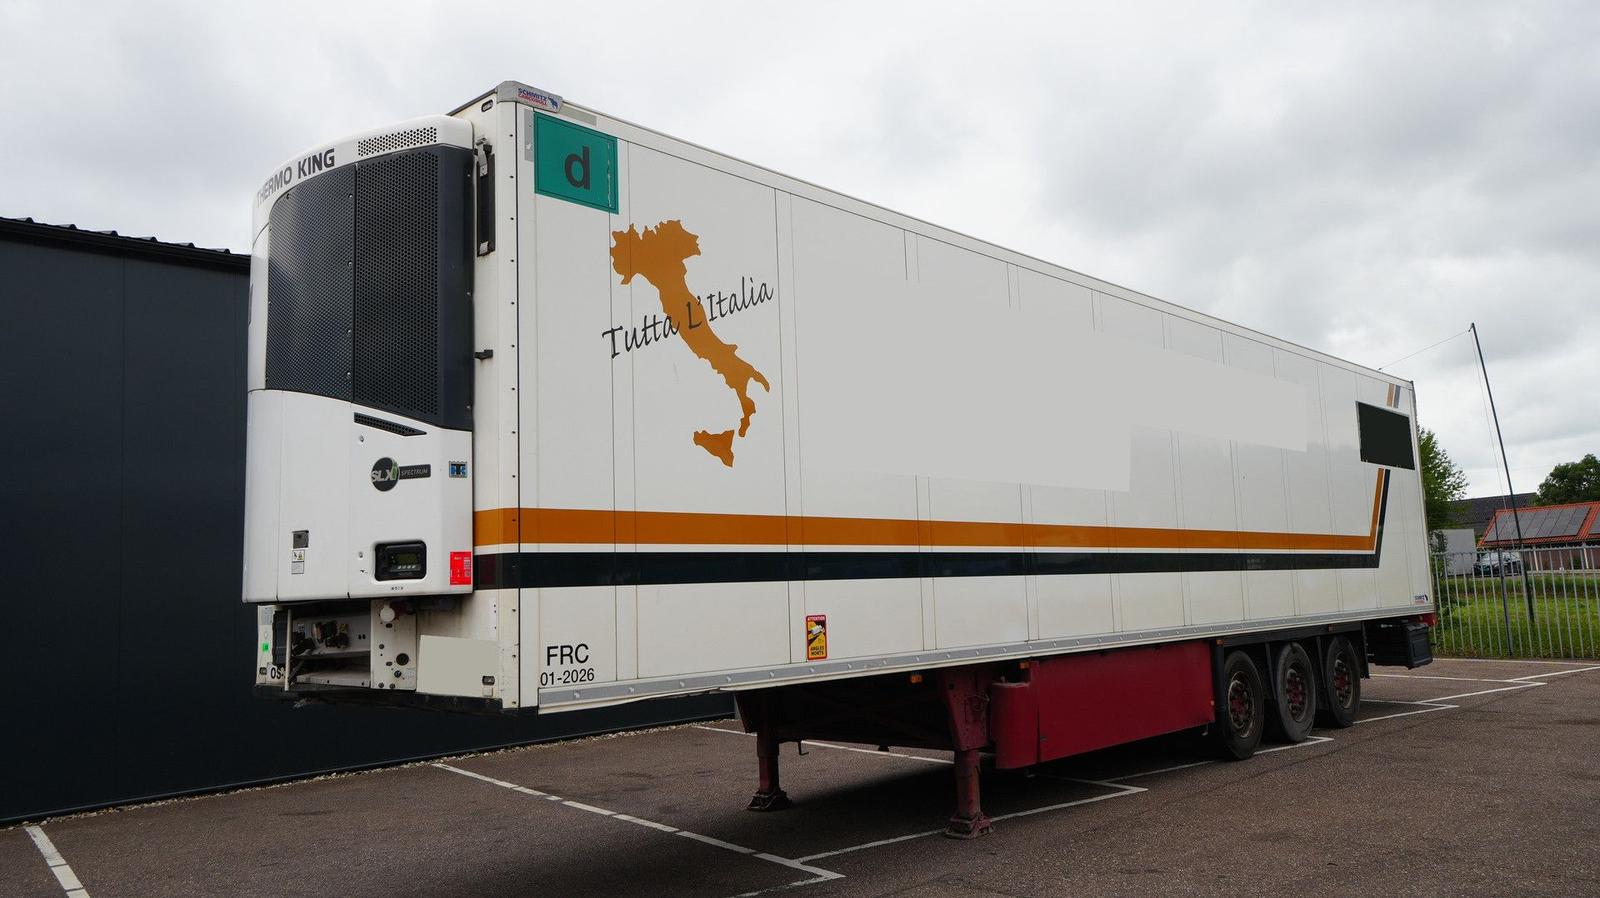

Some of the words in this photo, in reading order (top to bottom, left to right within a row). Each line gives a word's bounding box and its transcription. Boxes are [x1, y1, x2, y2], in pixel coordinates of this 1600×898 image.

[257, 166, 293, 208] THERMO
[298, 148, 335, 179] KING
[565, 146, 590, 190] d
[602, 315, 680, 359] Tutta
[401, 468, 428, 477] SPECTRUM
[547, 643, 589, 666] FRC
[540, 668, 594, 686] 01-2026
